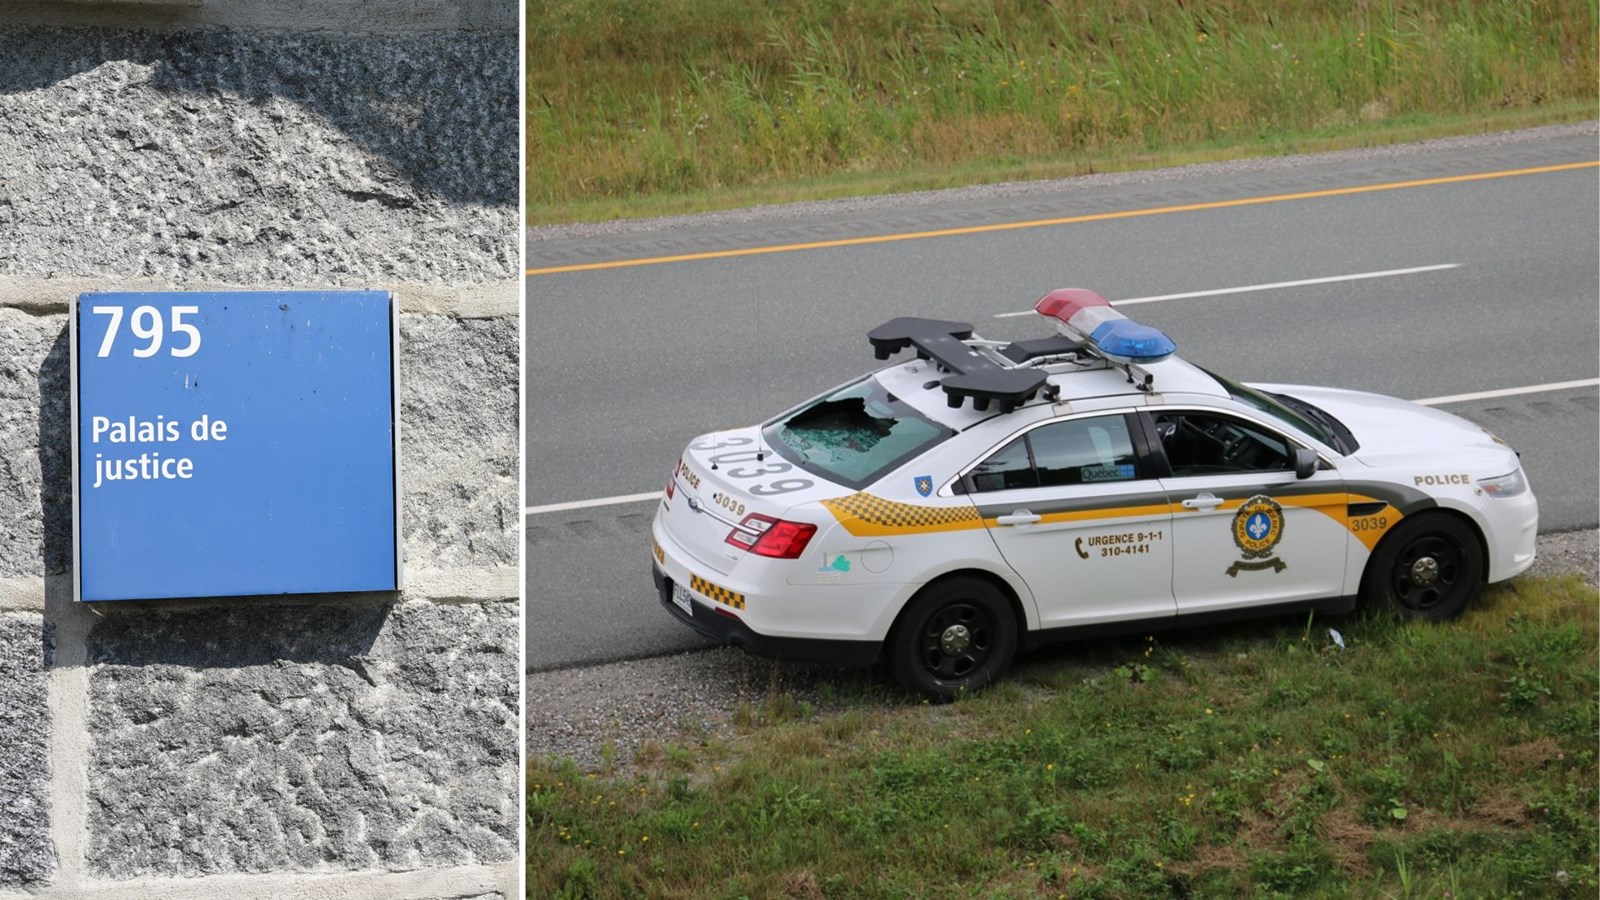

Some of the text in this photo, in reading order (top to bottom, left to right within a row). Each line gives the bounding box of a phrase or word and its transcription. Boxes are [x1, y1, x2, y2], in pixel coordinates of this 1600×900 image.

[92, 305, 202, 358] 795
[92, 414, 228, 443] Palais de
[93, 452, 194, 488] justice
[680, 463, 701, 490] POLICE
[688, 437, 815, 496] 3039
[1414, 474, 1470, 486] POLICE
[715, 493, 746, 516] 3039
[1352, 517, 1387, 531] 3039
[1088, 530, 1163, 546] URGENCE 9-1-1
[1101, 544, 1150, 557] 310-4141
